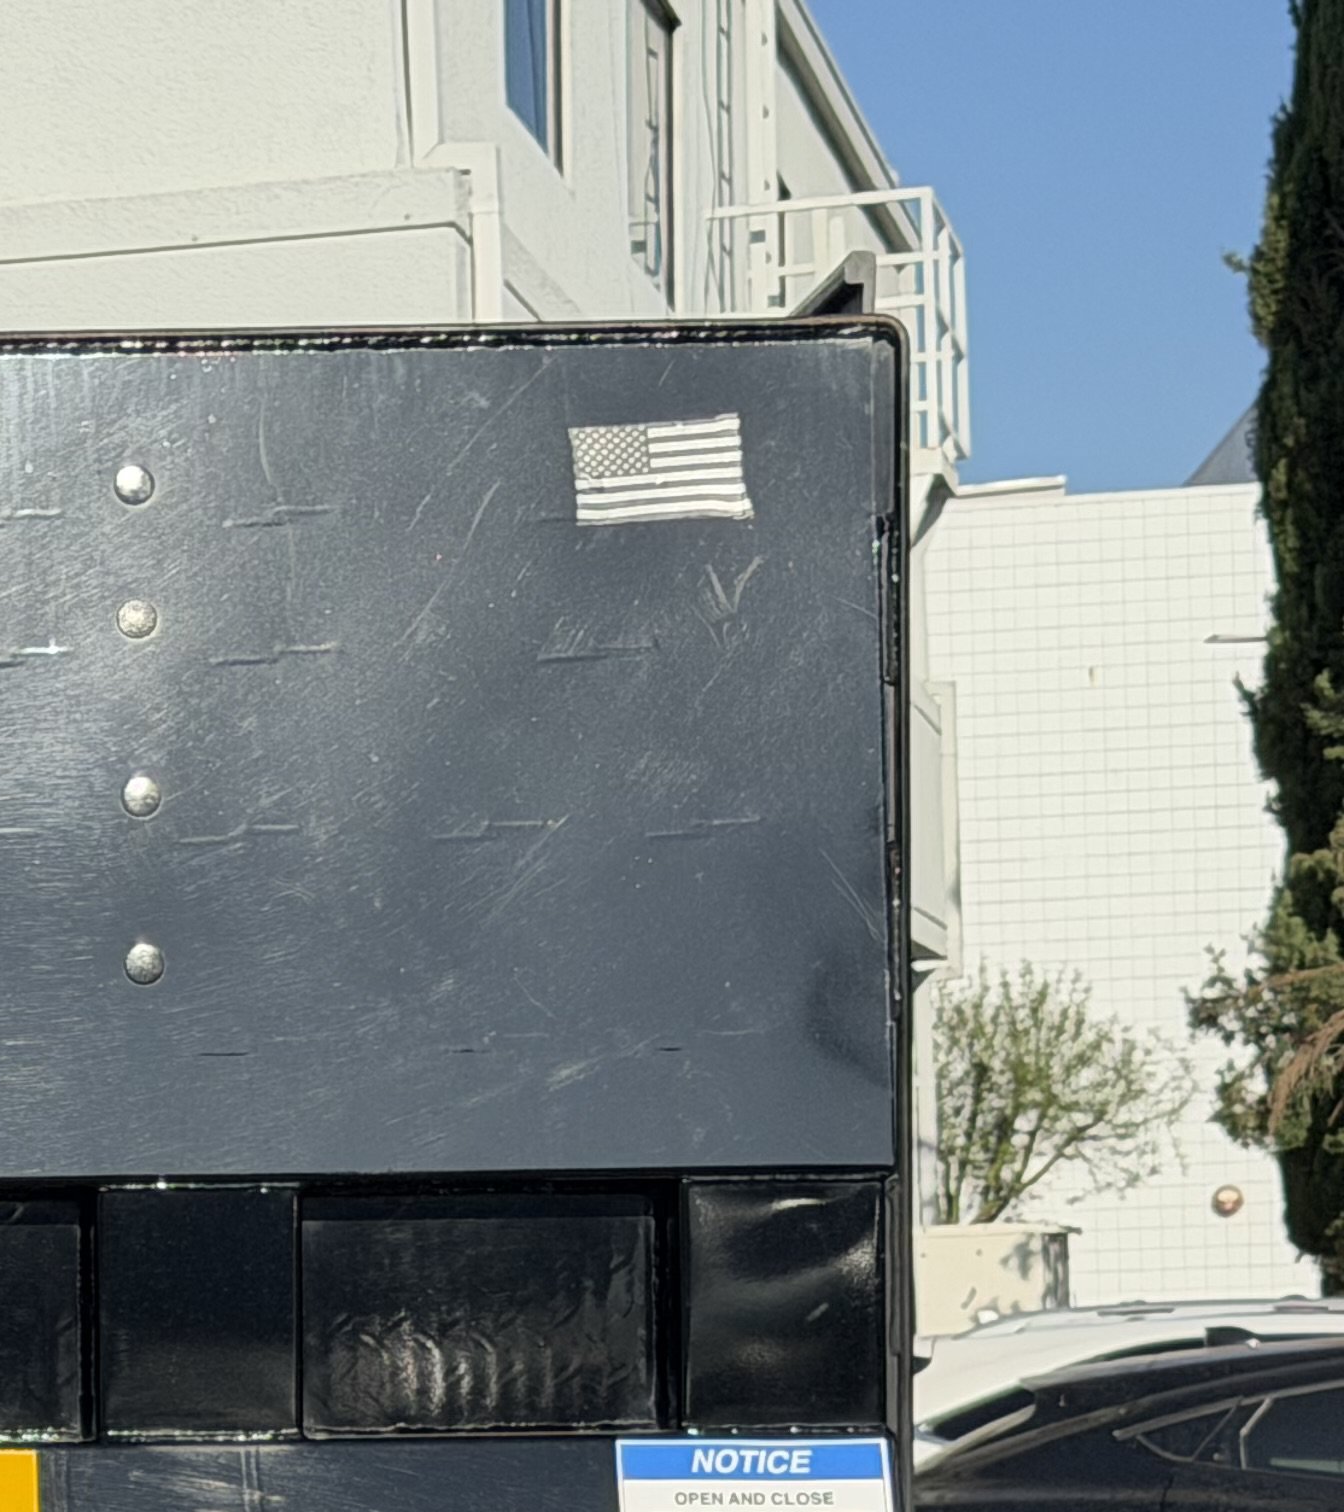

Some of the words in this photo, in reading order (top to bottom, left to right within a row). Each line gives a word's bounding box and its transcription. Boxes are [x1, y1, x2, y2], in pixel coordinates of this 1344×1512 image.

[691, 1448, 813, 1475] NOTICE
[674, 1492, 724, 1506] OPEN
[728, 1492, 766, 1506] AND
[770, 1491, 835, 1506] CLOSE
